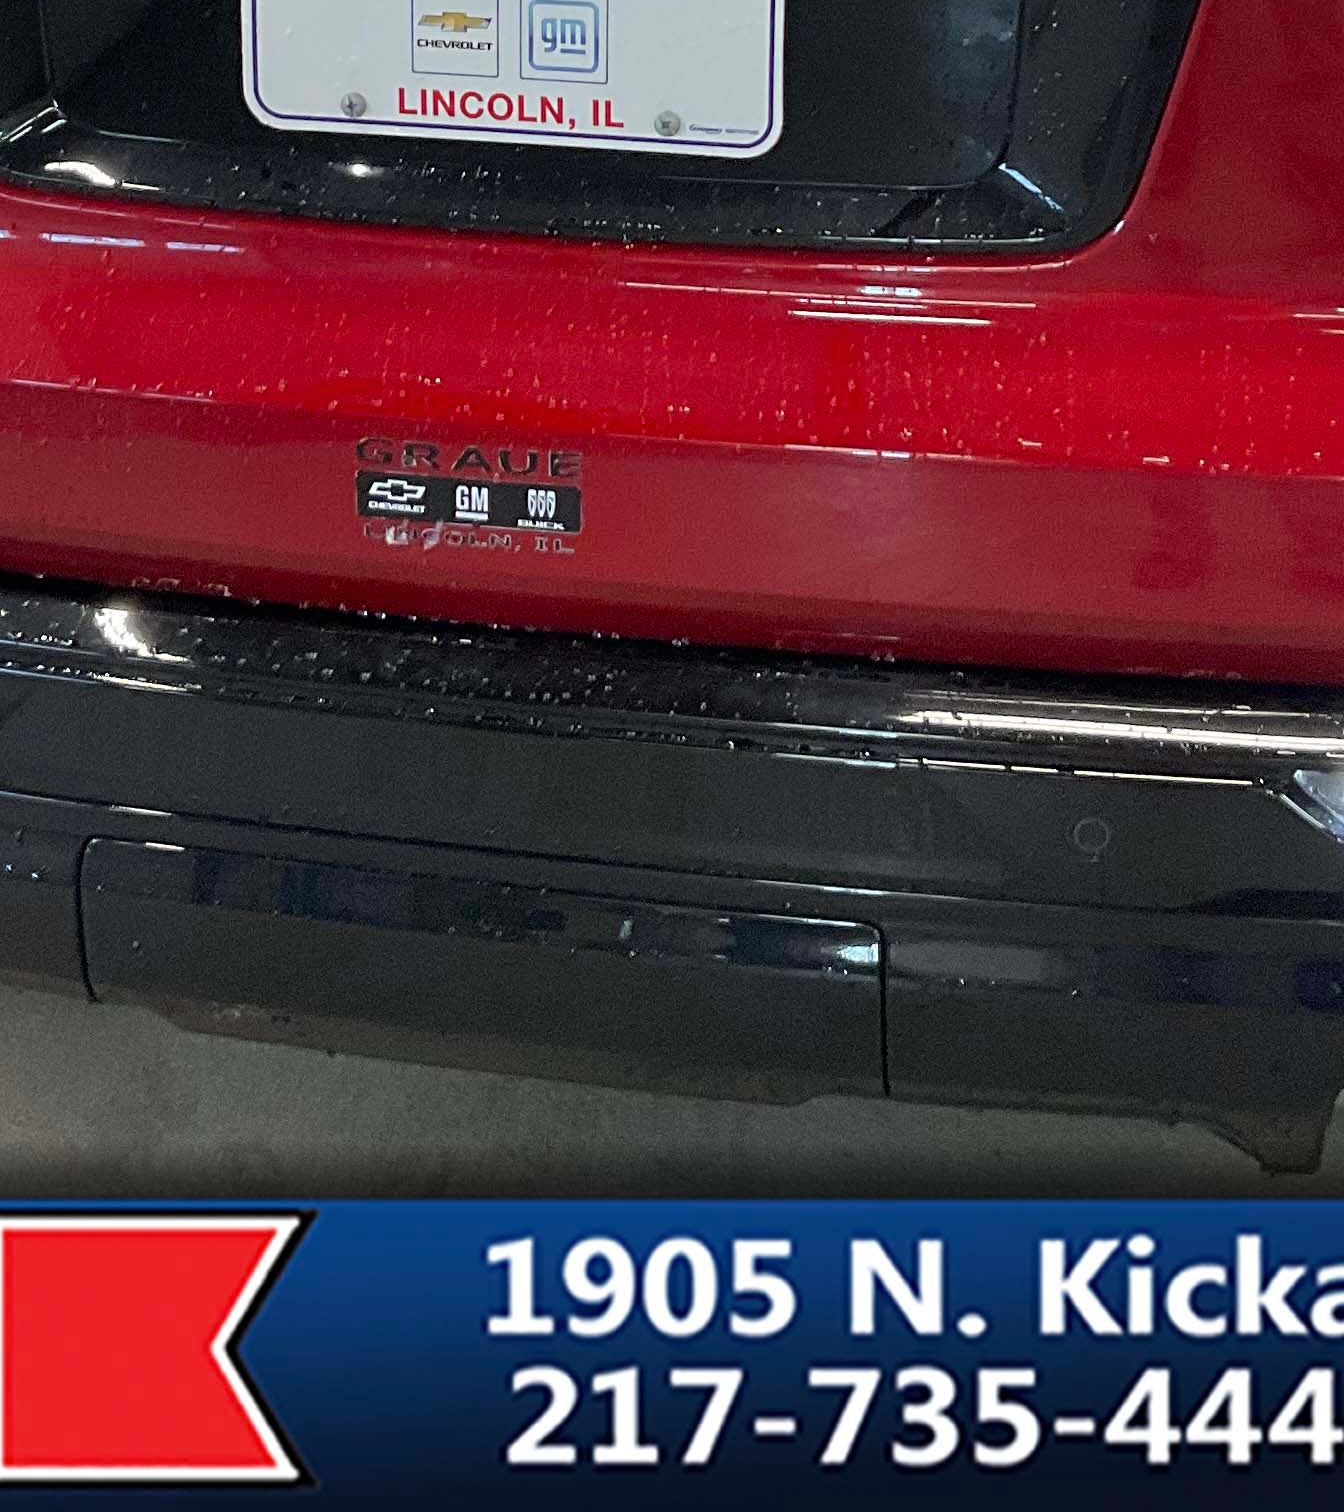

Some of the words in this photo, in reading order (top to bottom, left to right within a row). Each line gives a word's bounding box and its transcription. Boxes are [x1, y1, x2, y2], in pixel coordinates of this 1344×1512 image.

[415, 38, 494, 51] CHEVROLET
[540, 17, 588, 55] gm
[397, 87, 576, 130] LINCOLN,
[592, 100, 625, 128] IL
[355, 437, 583, 477] GRAUE
[454, 485, 490, 513] GM
[363, 521, 521, 552] LNCOLN,
[534, 535, 575, 554] IL
[516, 518, 565, 531] BUICK
